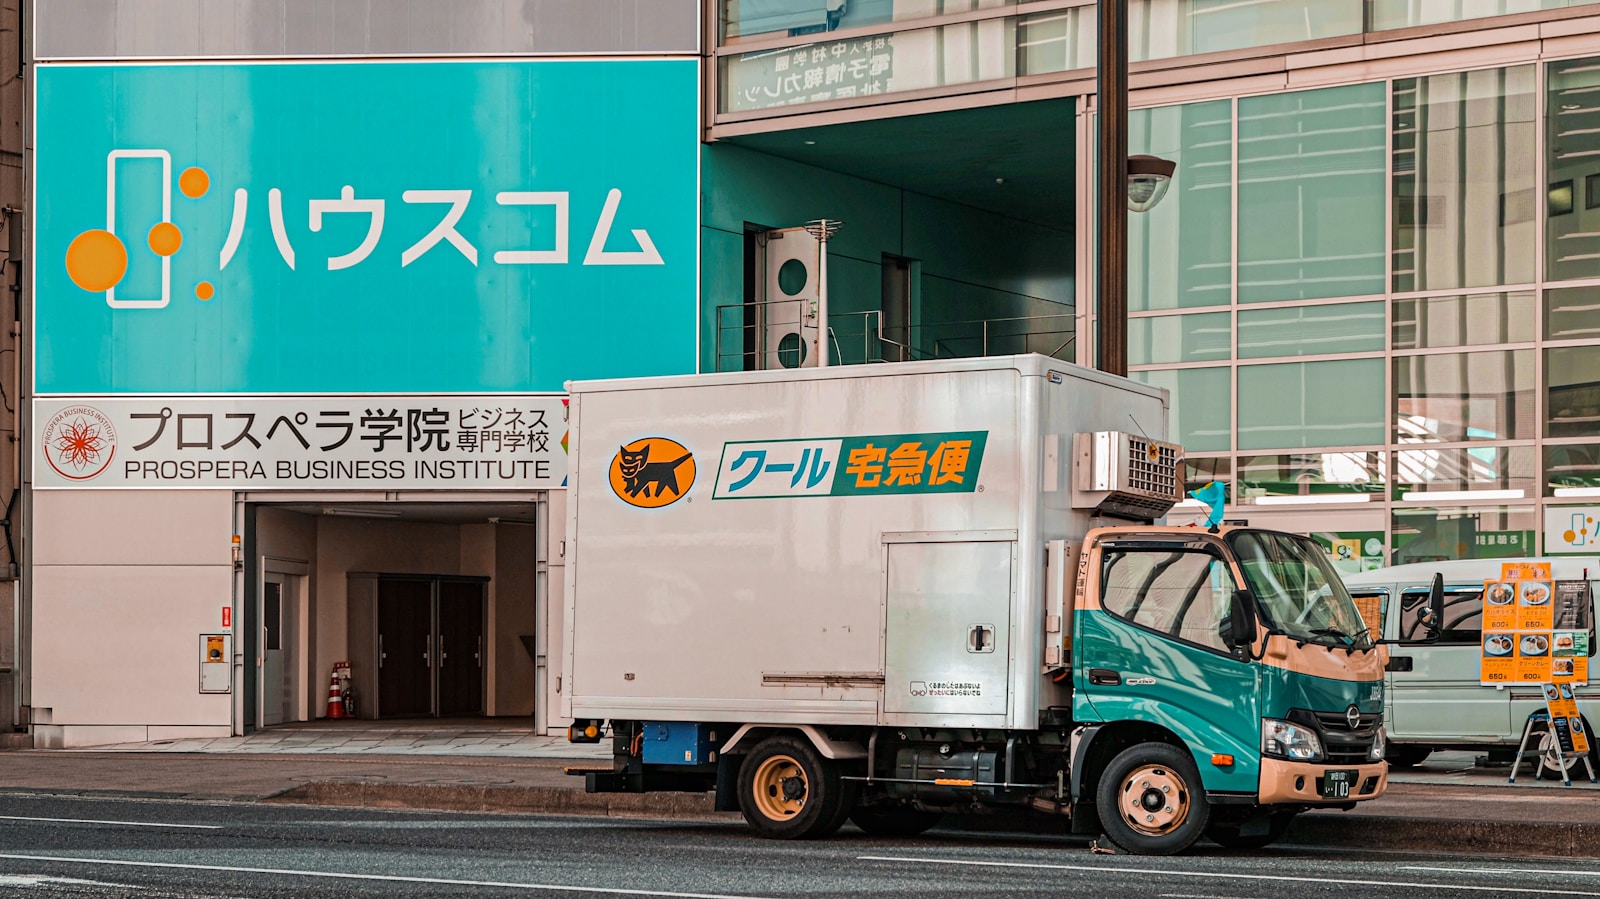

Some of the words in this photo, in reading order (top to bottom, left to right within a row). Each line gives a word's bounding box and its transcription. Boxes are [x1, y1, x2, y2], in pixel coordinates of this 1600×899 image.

[219, 185, 665, 271] ハウスコム
[46, 414, 63, 444] PROSPERA
[64, 407, 95, 417] BUSINESS
[95, 413, 114, 442] INSTITUTE
[130, 407, 451, 452] プロスペラ学院
[459, 408, 549, 430] ビジネス
[456, 430, 549, 453] 専門学校
[125, 460, 267, 479] PROSPERA
[276, 460, 405, 479] BUSINESS
[415, 460, 550, 479] INSTITUTE
